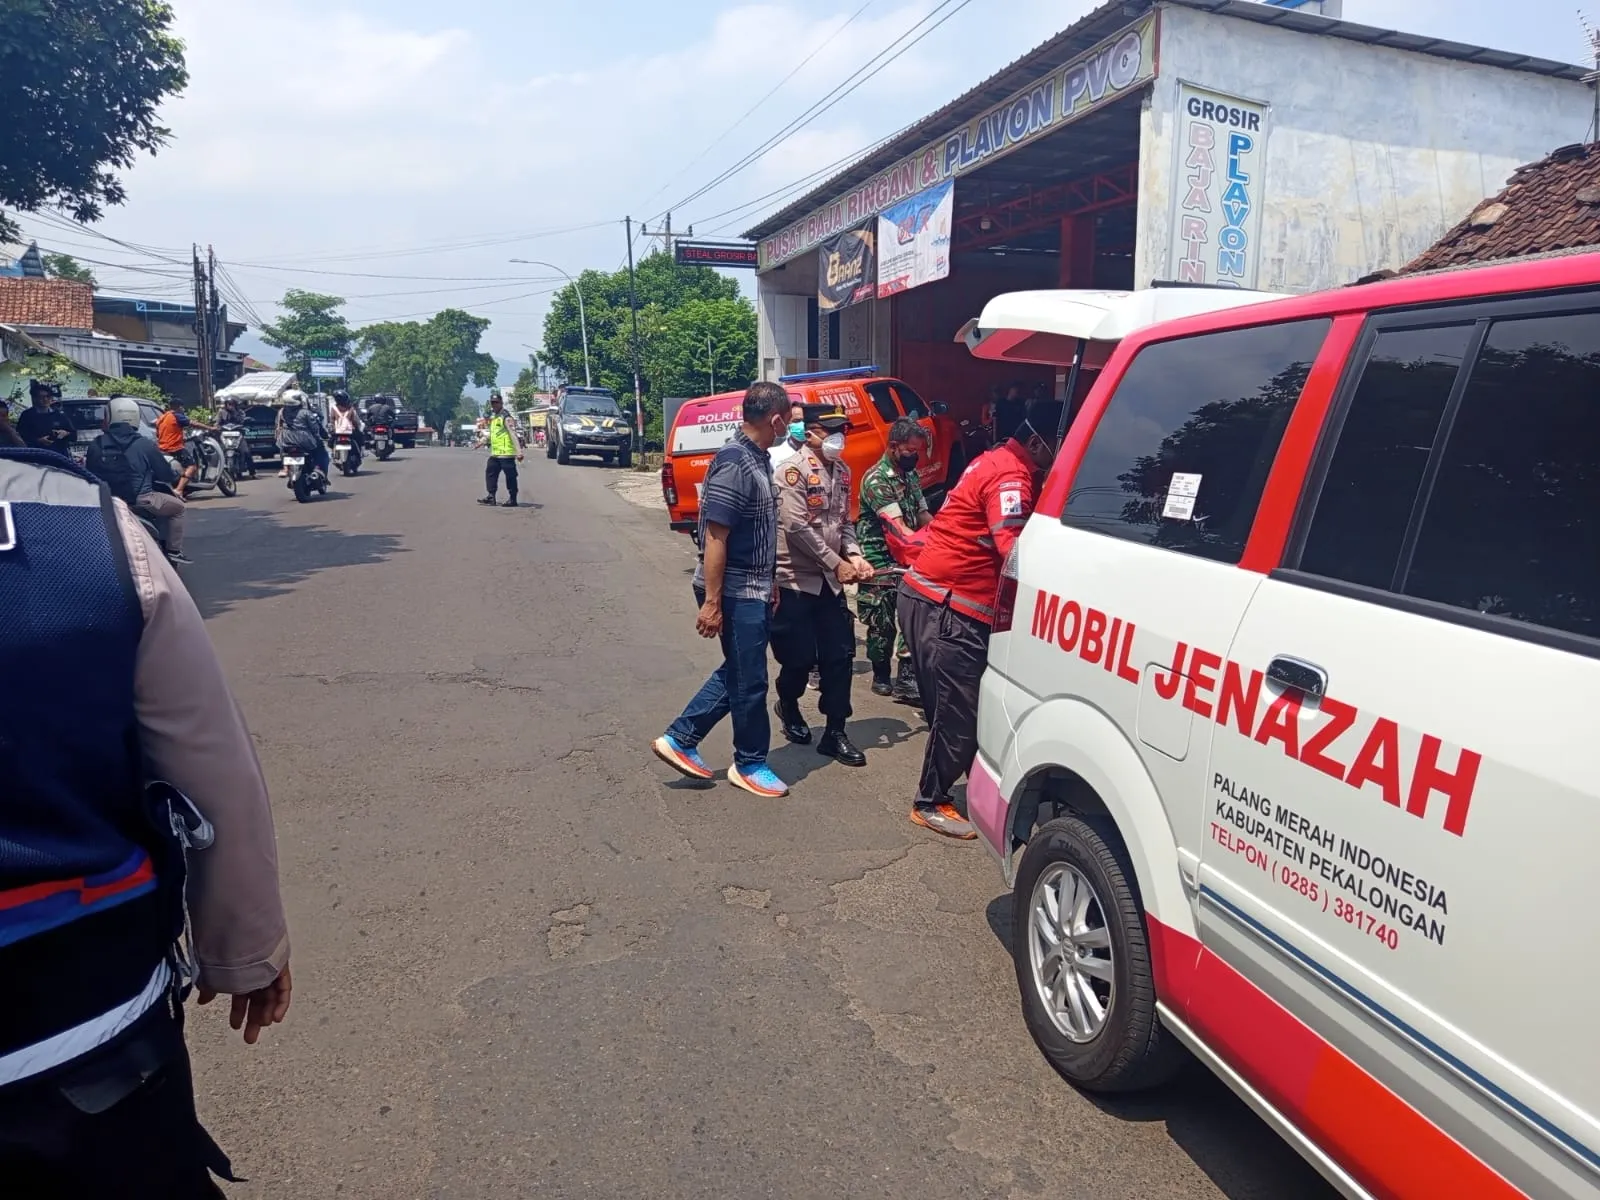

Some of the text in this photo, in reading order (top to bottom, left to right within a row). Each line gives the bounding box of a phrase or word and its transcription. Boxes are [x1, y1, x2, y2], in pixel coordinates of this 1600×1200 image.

[765, 226, 805, 265] PUSAT
[807, 202, 844, 245] BAJA
[846, 158, 917, 225] RINGAN
[920, 150, 939, 187] &
[943, 78, 1055, 176] PLAVON
[1061, 31, 1142, 117] PVC
[1182, 121, 1215, 213] BAJA
[1187, 97, 1260, 132] GROSIR
[686, 250, 712, 259] STEAL
[714, 251, 745, 260] GROSIR
[1217, 130, 1253, 277] PLAVON
[697, 412, 734, 423] POLRI
[1031, 589, 1482, 837] MOBIL JENAZAH
[1210, 822, 1268, 872] TELPON
[1281, 866, 1319, 902] 0285
[1333, 897, 1399, 950] 381740
[1213, 773, 1448, 915] PALANG MERAH INDONESIA
[1216, 799, 1446, 946] KABUPATEN PEKALONGAN
